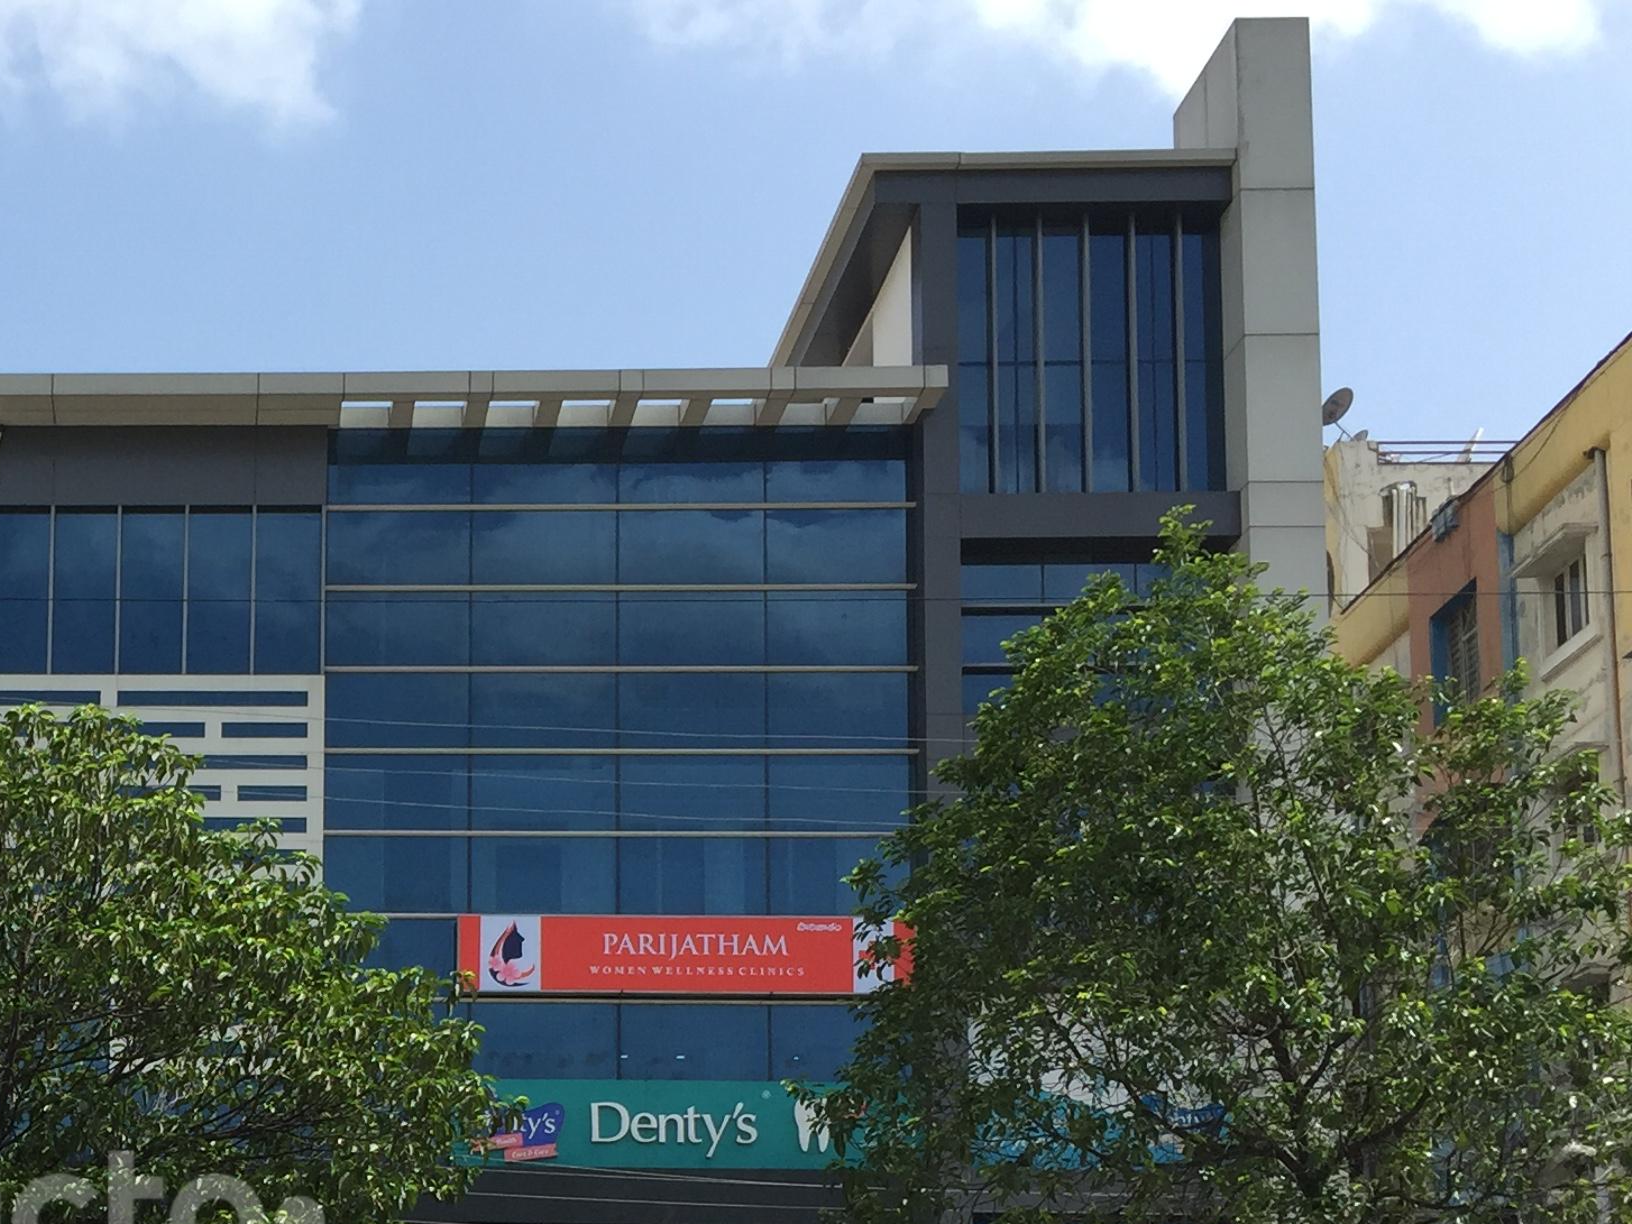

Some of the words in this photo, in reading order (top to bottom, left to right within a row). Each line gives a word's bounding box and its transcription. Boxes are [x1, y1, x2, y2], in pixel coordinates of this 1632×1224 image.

[602, 932, 789, 960] PARIJATHAM
[589, 965, 647, 976] WOMEN
[652, 966, 734, 976] WELLNESS
[738, 966, 805, 977] CLINICS
[589, 1101, 758, 1159] Denty's
